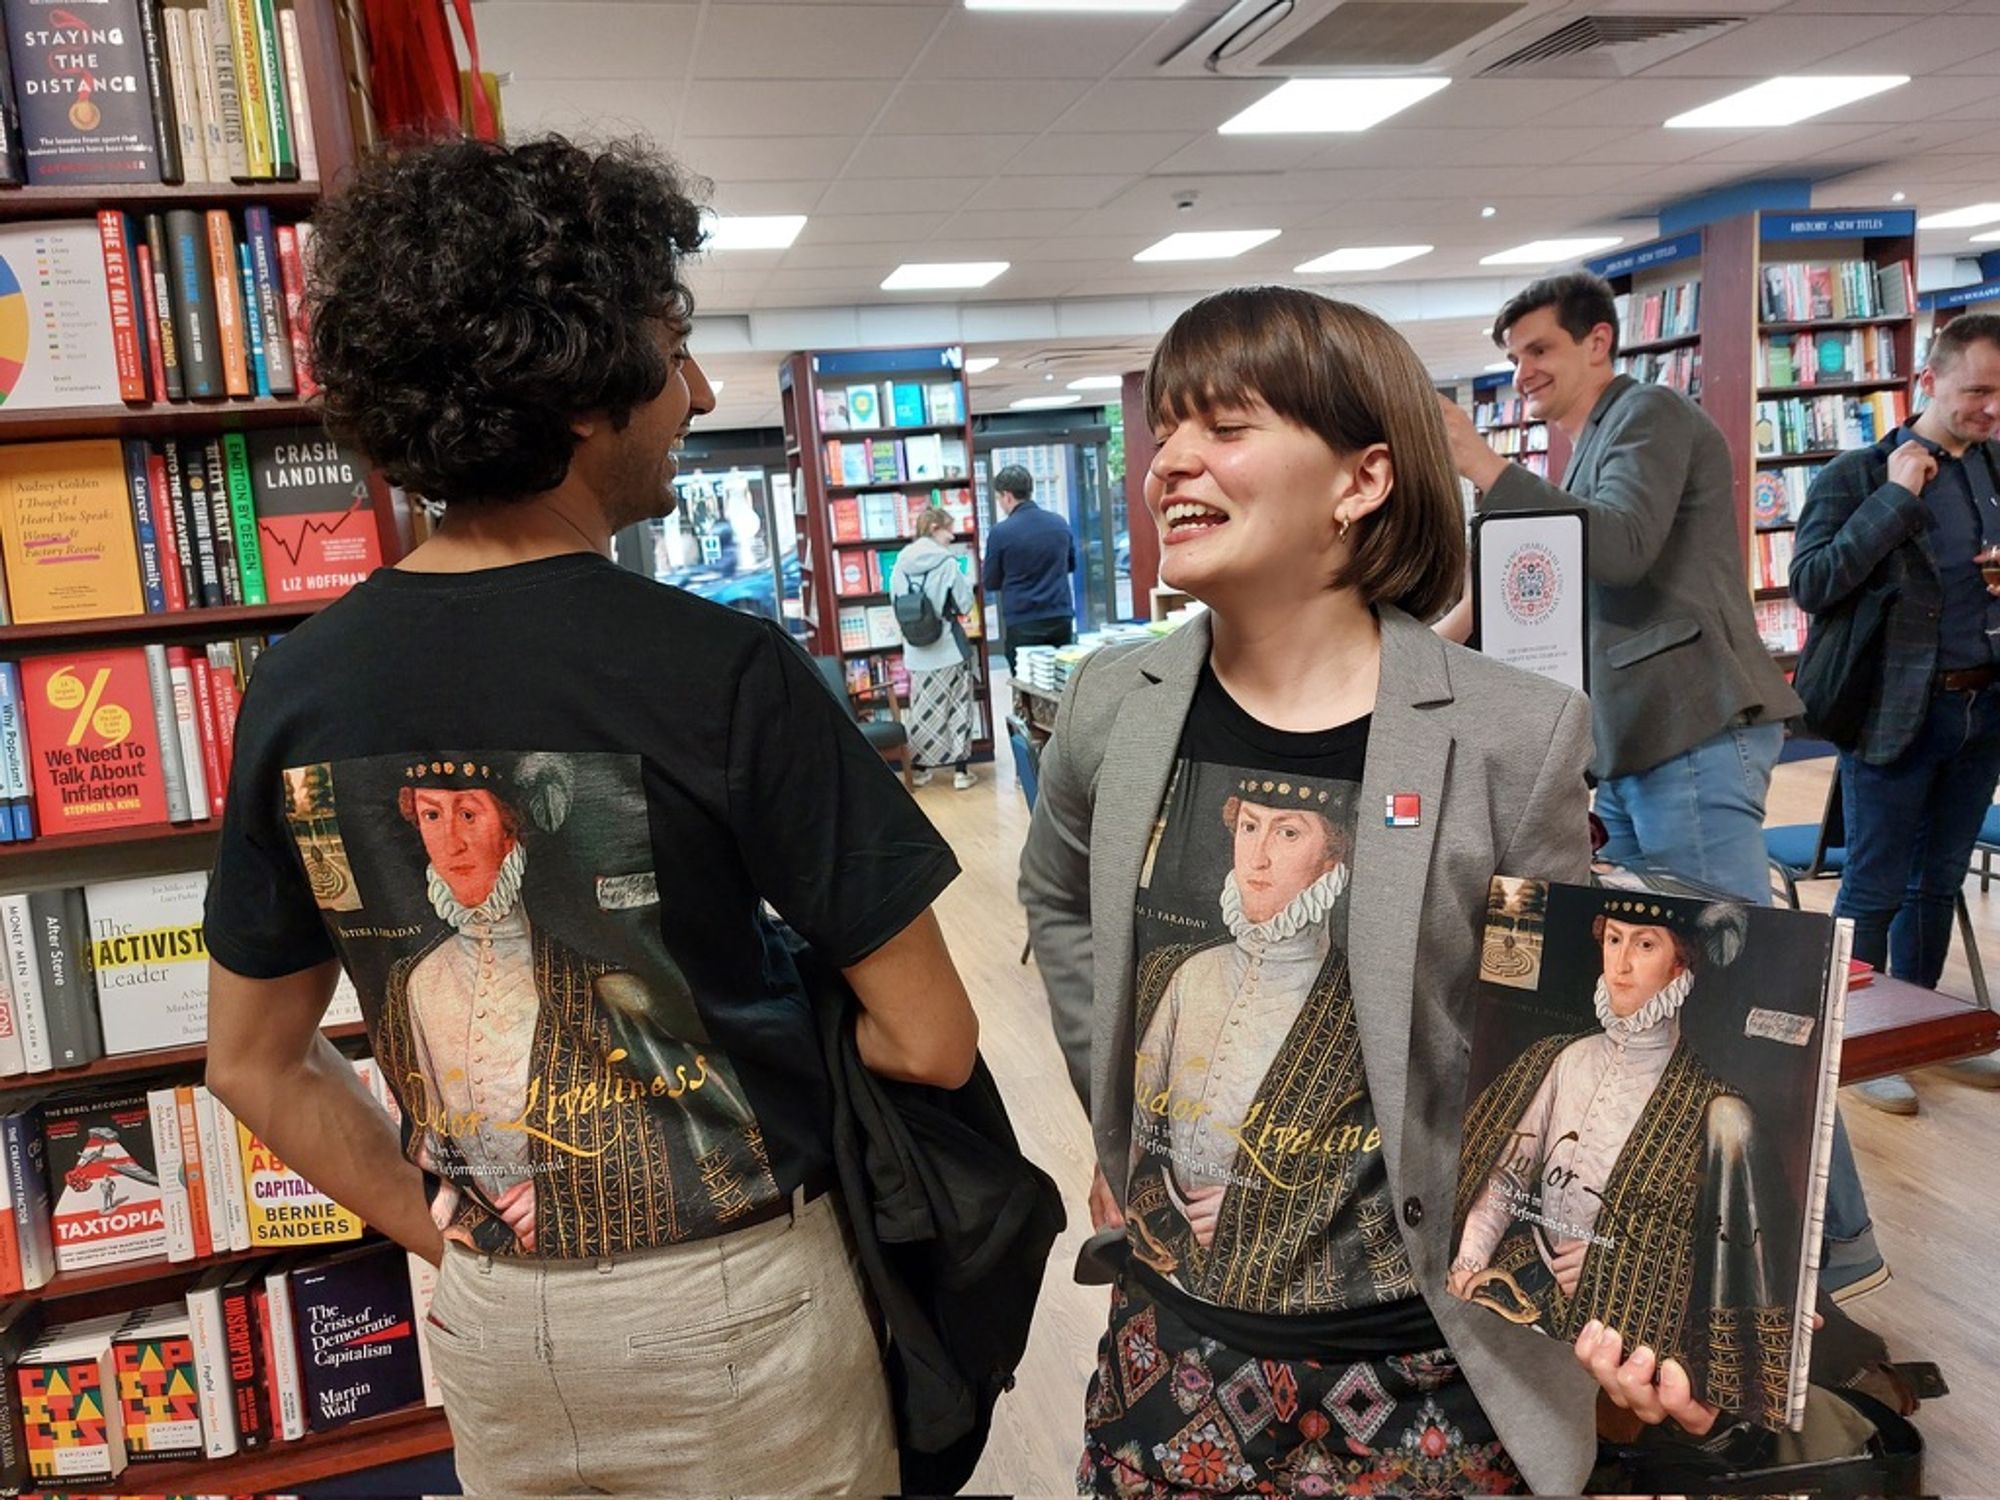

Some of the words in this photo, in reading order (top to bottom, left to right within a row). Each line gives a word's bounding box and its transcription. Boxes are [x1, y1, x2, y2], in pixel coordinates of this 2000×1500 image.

[25, 27, 124, 46] STAYING
[241, 25, 254, 60] LEGO
[55, 54, 98, 68] THE
[215, 44, 231, 62] THE
[26, 75, 136, 94] DISTANCE
[217, 66, 236, 91] NEW
[246, 62, 260, 104] STORY
[220, 94, 242, 145] GOLIATHS
[1791, 221, 1827, 232] HISTORY
[1834, 220, 1854, 231] NEW
[1856, 219, 1884, 230] TITLES
[107, 253, 126, 285] KEY
[255, 236, 270, 280] MARKETS,
[112, 290, 130, 327] MAN
[259, 283, 274, 313] STATE,
[246, 280, 254, 294] TO
[250, 310, 260, 343] CLEAR
[266, 315, 275, 334] AND
[160, 320, 176, 367] CARING
[268, 336, 282, 371] PEOPLE
[166, 444, 179, 474] INTO
[274, 442, 339, 465] CRASH
[230, 444, 248, 500] EMOTION
[265, 464, 354, 489] LANDING
[16, 480, 55, 493] Audrey
[58, 478, 100, 490] Golden
[170, 476, 183, 498] THE
[27, 496, 70, 510] Thought
[192, 492, 210, 538] RESTARTING
[238, 504, 250, 521] BY
[20, 514, 54, 526] Heard
[58, 513, 76, 523] You
[134, 476, 150, 524] Career
[144, 544, 160, 590] Family
[173, 500, 192, 566] METAVERSE
[66, 542, 106, 554] Records
[198, 540, 212, 554] THE
[240, 524, 256, 575] DESIGN.
[201, 556, 217, 586] FUTURE
[281, 578, 302, 592] LIZ
[306, 572, 368, 590] HOFFMAN
[198, 664, 209, 699] PATRICK
[4, 704, 14, 728] Why
[6, 732, 23, 789] Populism?
[44, 750, 72, 766] We
[76, 743, 122, 764] Need
[125, 742, 146, 759] To
[49, 768, 85, 786] Talk
[90, 761, 146, 781] About
[61, 782, 139, 804] Inflation
[64, 802, 104, 816] STEPHEN
[8, 906, 24, 946] MONEY
[46, 916, 60, 948] After
[94, 918, 132, 938] The
[1158, 911, 1210, 930] FARADAY
[100, 927, 204, 966] ACTIVIST
[14, 951, 28, 976] MEN
[50, 951, 65, 986] Steve
[102, 964, 169, 990] Leader
[92, 1097, 147, 1112] ACCOUNTAN
[496, 1047, 708, 1158] Liveliness
[508, 1154, 566, 1176] England
[1208, 1160, 1262, 1191] England
[255, 1178, 323, 1199] CAPITAL
[1513, 1188, 1530, 1202] Art
[16, 1192, 28, 1225] FACTOR
[265, 1203, 336, 1222] BERNIE
[57, 1208, 164, 1240] TAXTOPIA
[258, 1219, 350, 1240] SANDERS
[1571, 1224, 1615, 1249] England
[306, 1304, 340, 1321] The
[310, 1313, 354, 1335] Crisis
[356, 1306, 372, 1322] of
[224, 1296, 254, 1380] UNSCRIPTED
[312, 1314, 398, 1351] Democratic
[314, 1344, 392, 1368] Capitalism
[202, 1365, 215, 1392] PayPal
[319, 1382, 371, 1404] Martin
[320, 1398, 357, 1420] Wolf
